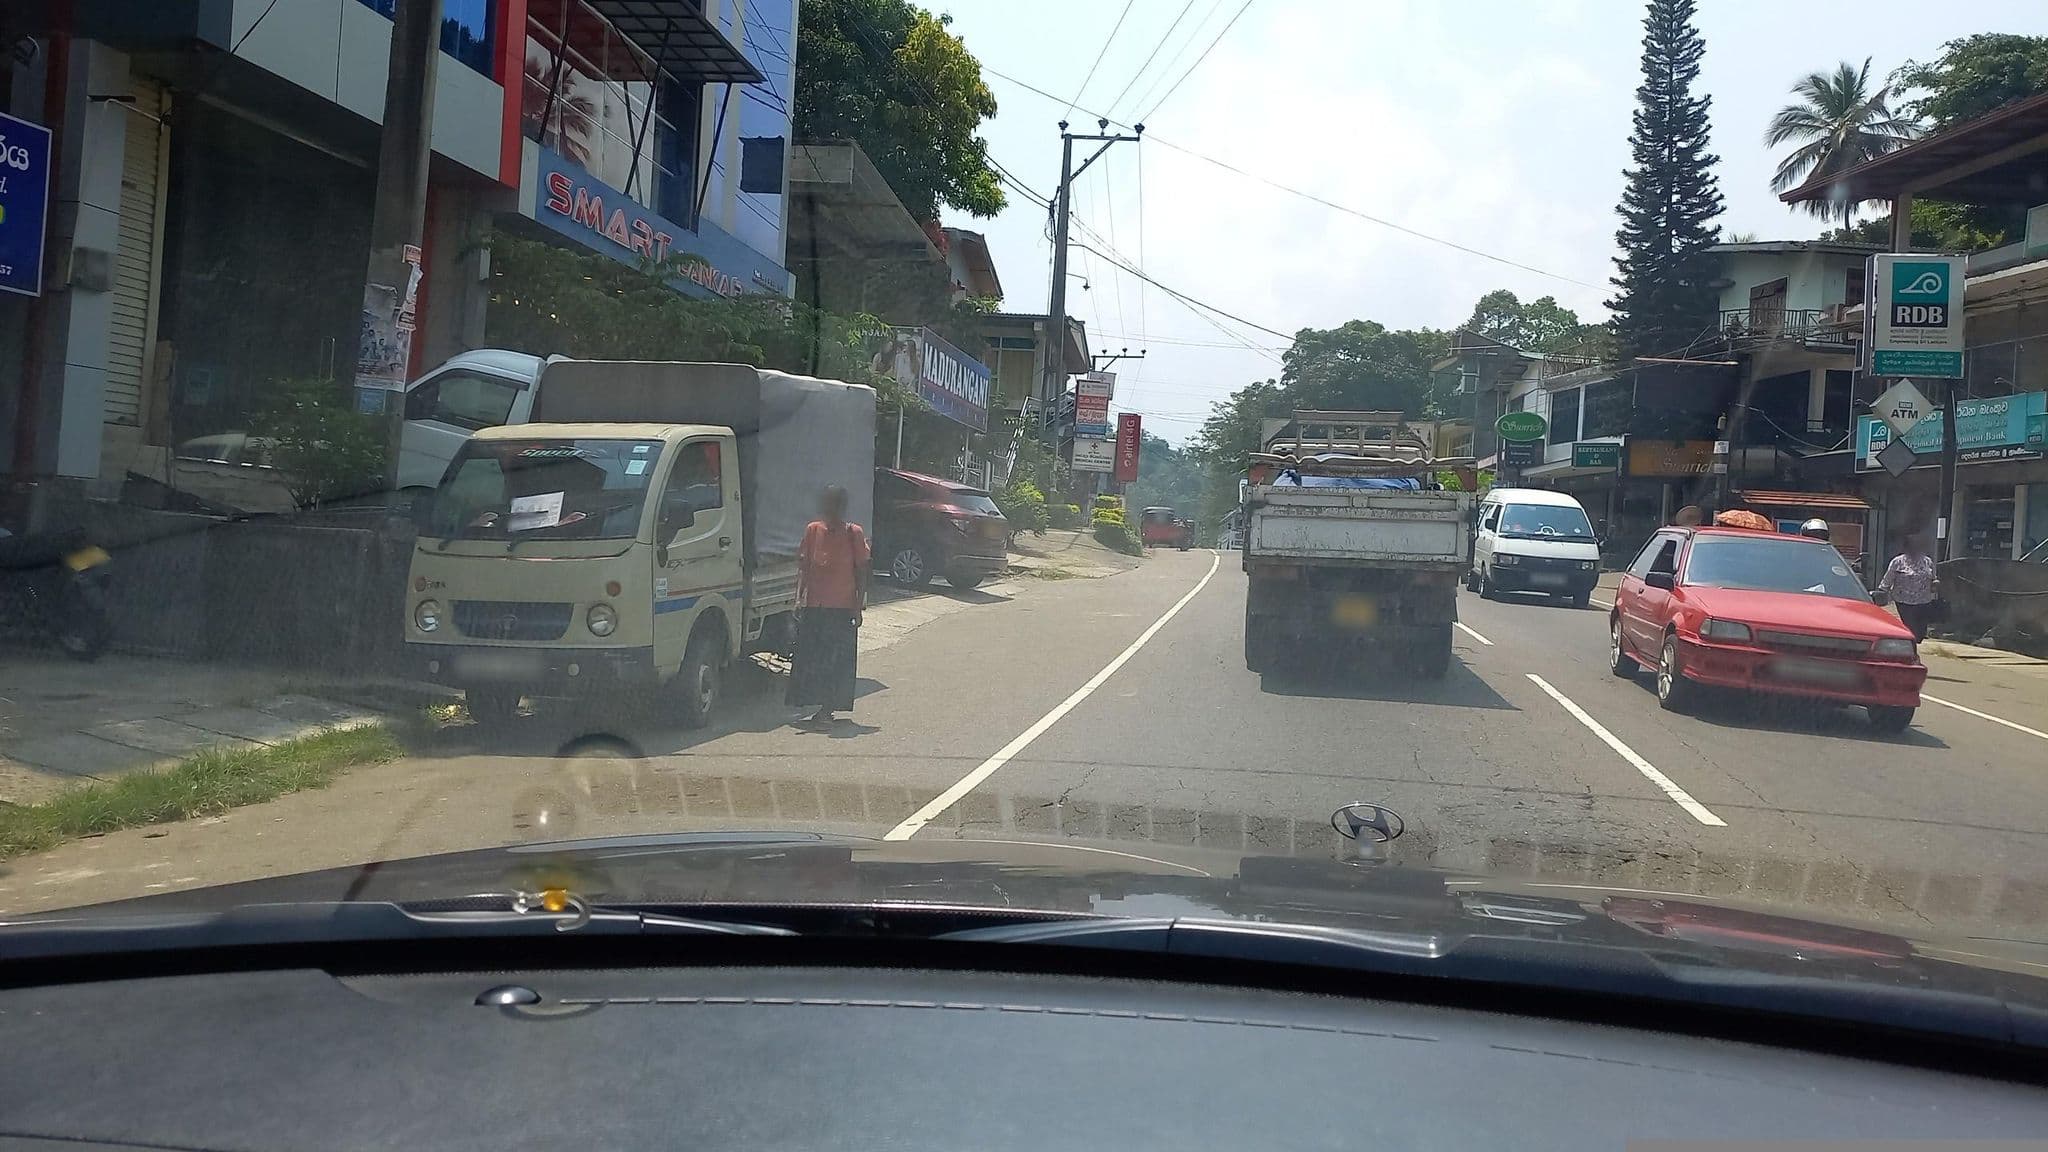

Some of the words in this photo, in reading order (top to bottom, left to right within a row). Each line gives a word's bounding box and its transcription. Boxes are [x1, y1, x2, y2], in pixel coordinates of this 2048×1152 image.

[545, 171, 673, 265] SMART
[1896, 306, 1944, 324] RDB
[922, 342, 989, 410] MADURANGANI
[1891, 409, 1919, 420] ATM
[1986, 430, 2006, 441] Bank
[1871, 441, 1886, 451] RDB
